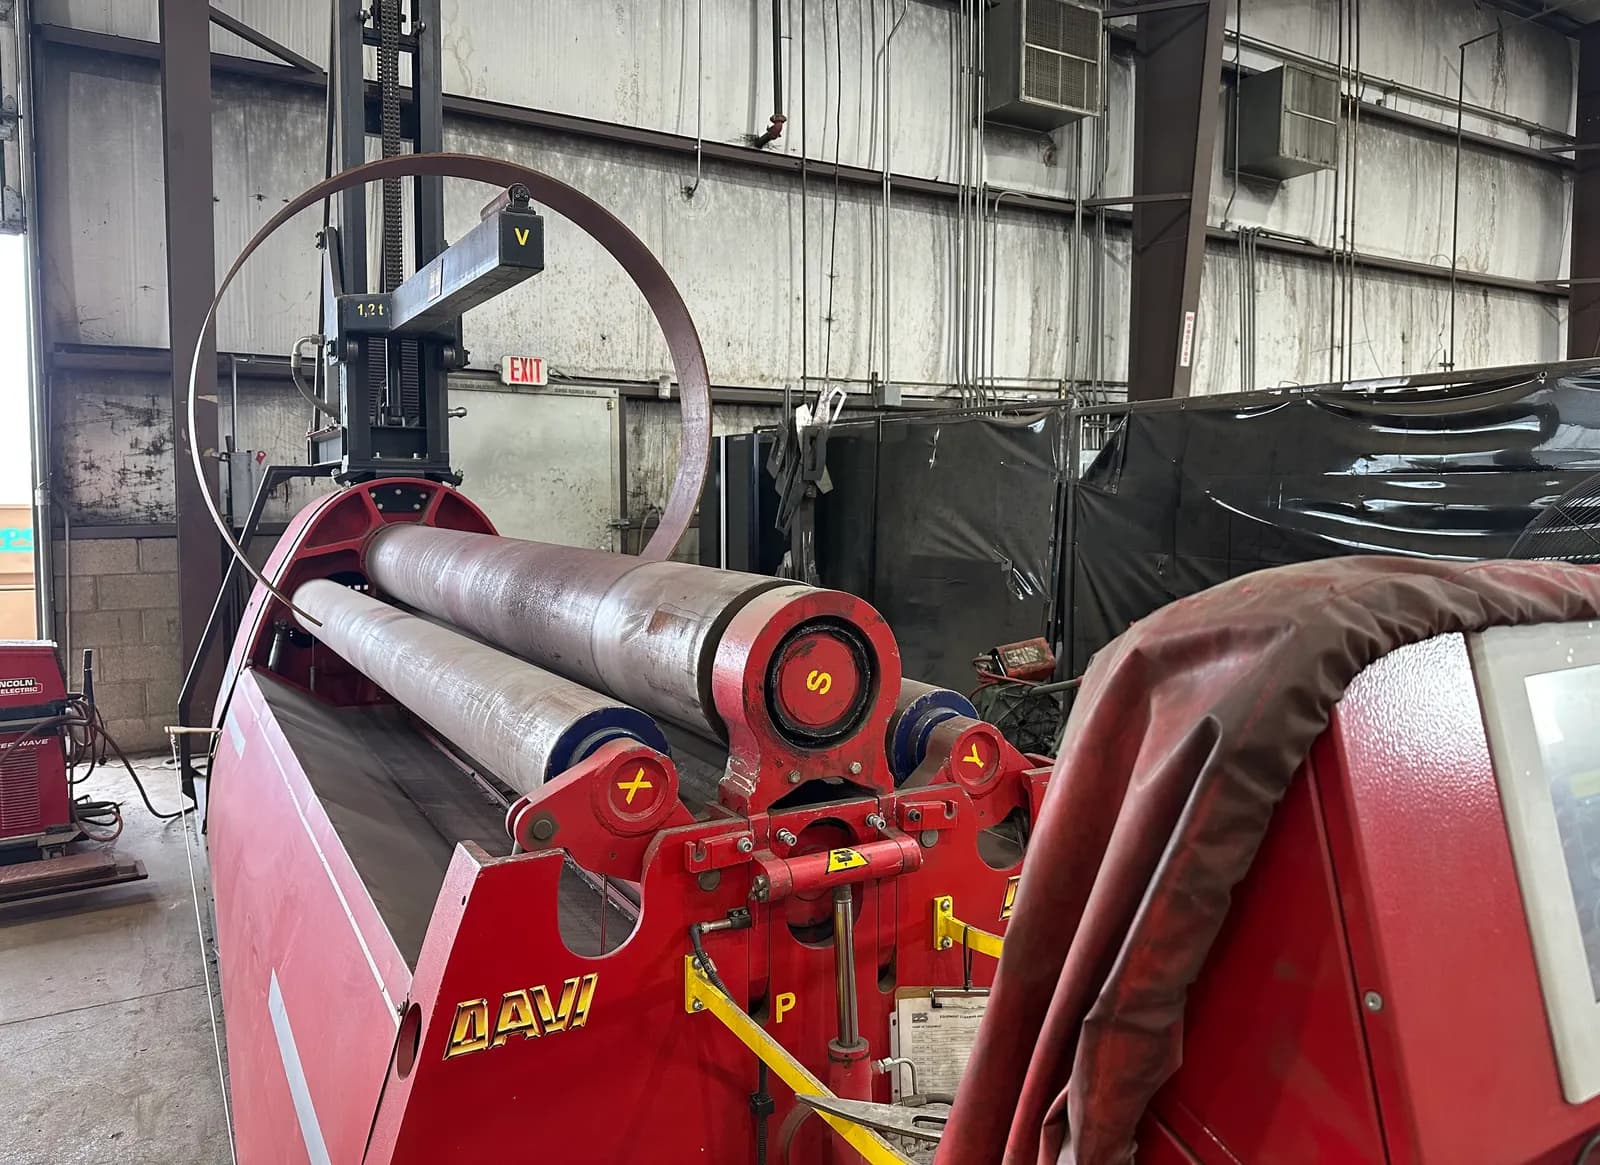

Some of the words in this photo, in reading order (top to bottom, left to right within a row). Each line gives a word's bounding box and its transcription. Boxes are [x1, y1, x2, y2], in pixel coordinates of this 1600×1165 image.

[514, 227, 530, 246] V
[377, 303, 384, 316] t
[509, 356, 543, 383] EXIT
[0, 687, 38, 695] ELECTRIC
[806, 670, 832, 695] S
[962, 742, 985, 769] Y
[617, 767, 653, 805] X
[443, 972, 598, 1061] DAVI
[775, 992, 796, 1024] P
